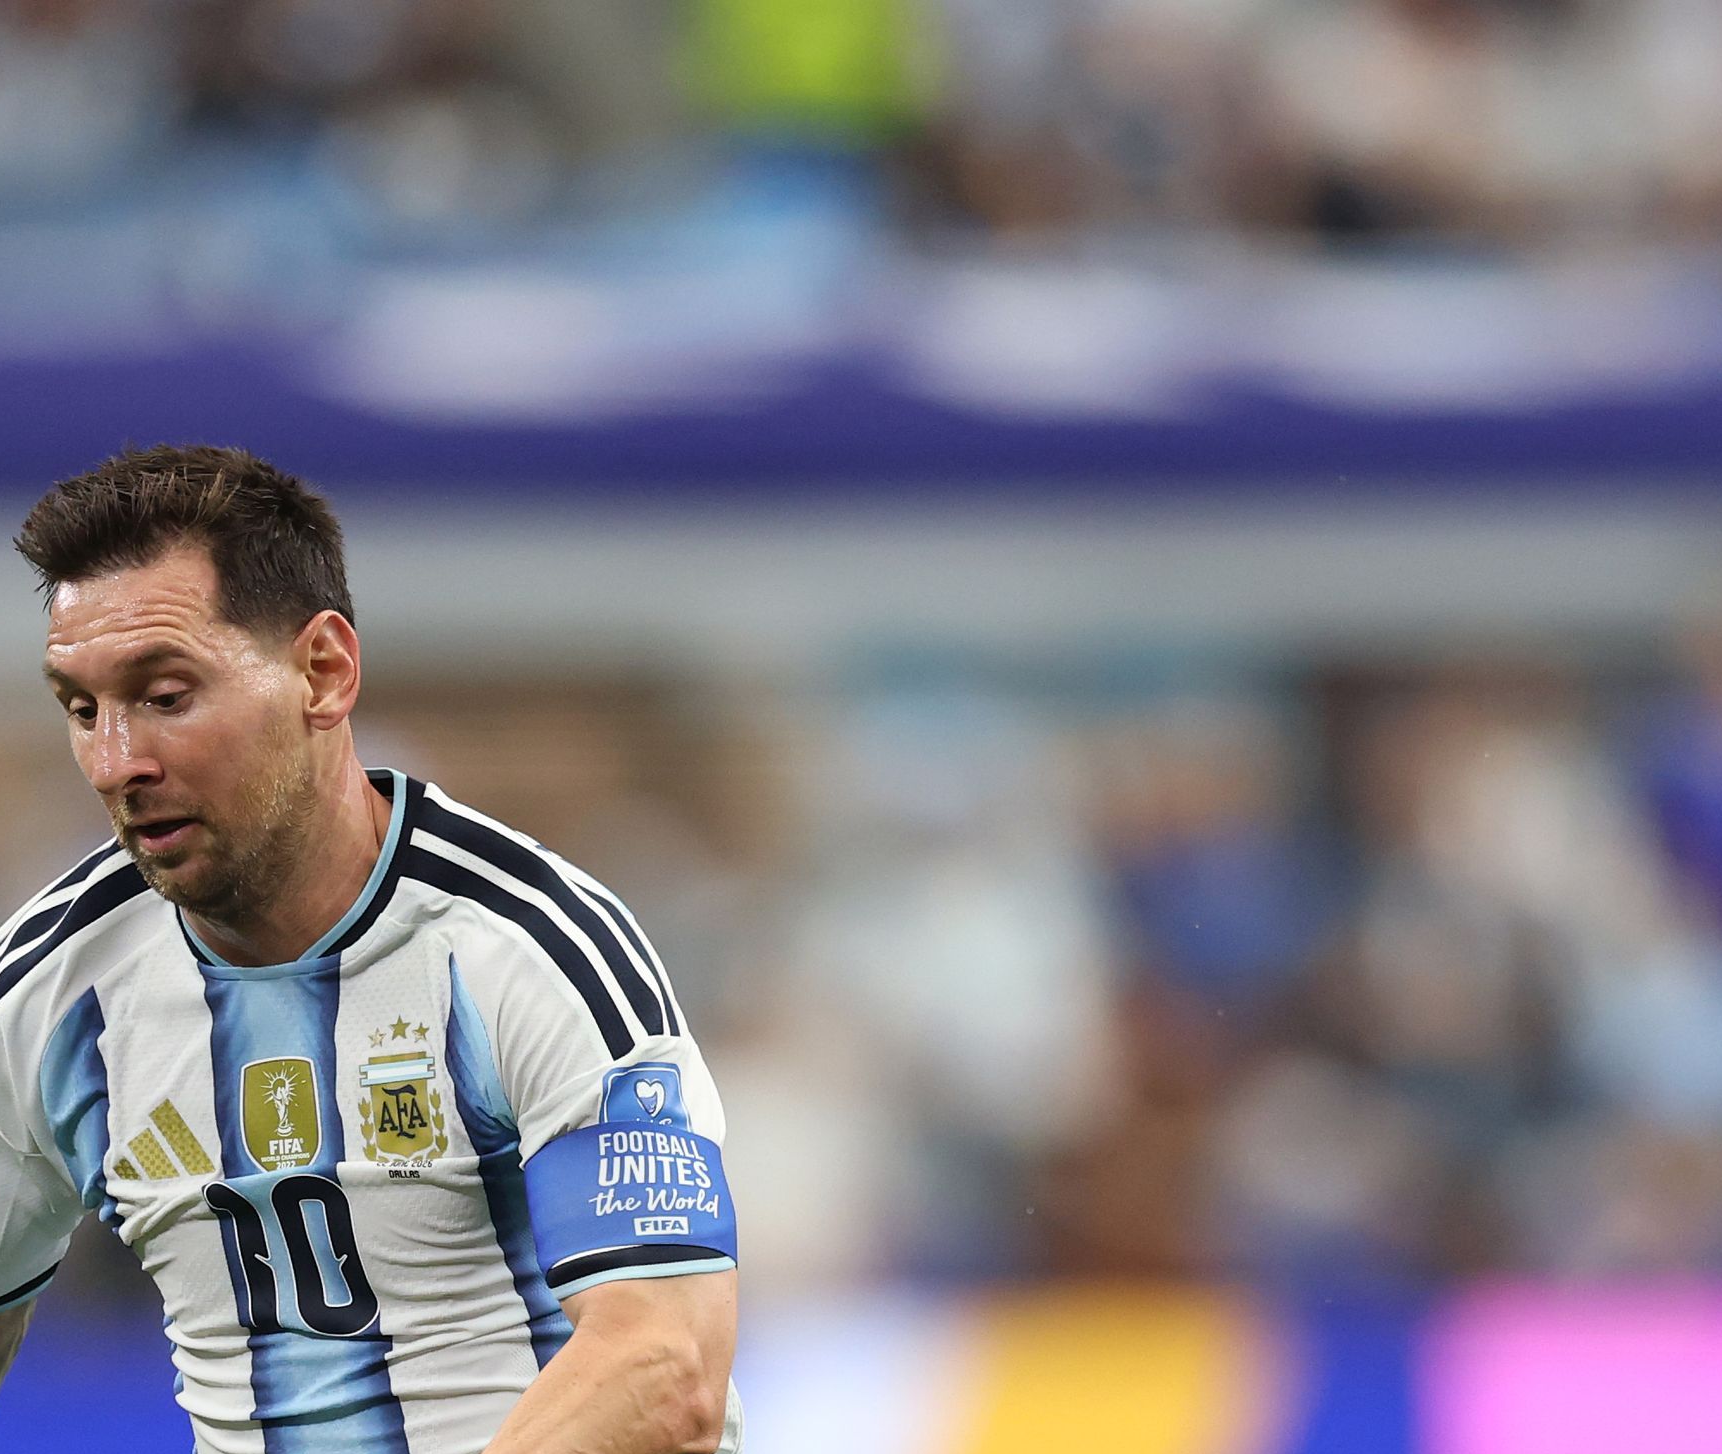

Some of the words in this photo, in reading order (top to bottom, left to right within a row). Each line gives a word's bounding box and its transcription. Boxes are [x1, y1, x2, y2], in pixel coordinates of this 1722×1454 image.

[378, 1084, 428, 1139] AFA
[261, 1155, 280, 1163] WORLD
[280, 1152, 310, 1161] CHAMPIONS
[269, 1137, 304, 1155] FIFA
[598, 1131, 705, 1160] FOOTBALL
[388, 1169, 421, 1179] DALLAS
[598, 1155, 712, 1188] UNITES
[588, 1188, 641, 1217] the
[645, 1187, 719, 1219] World
[640, 1219, 685, 1232] FIFA
[203, 1174, 380, 1337] 10
